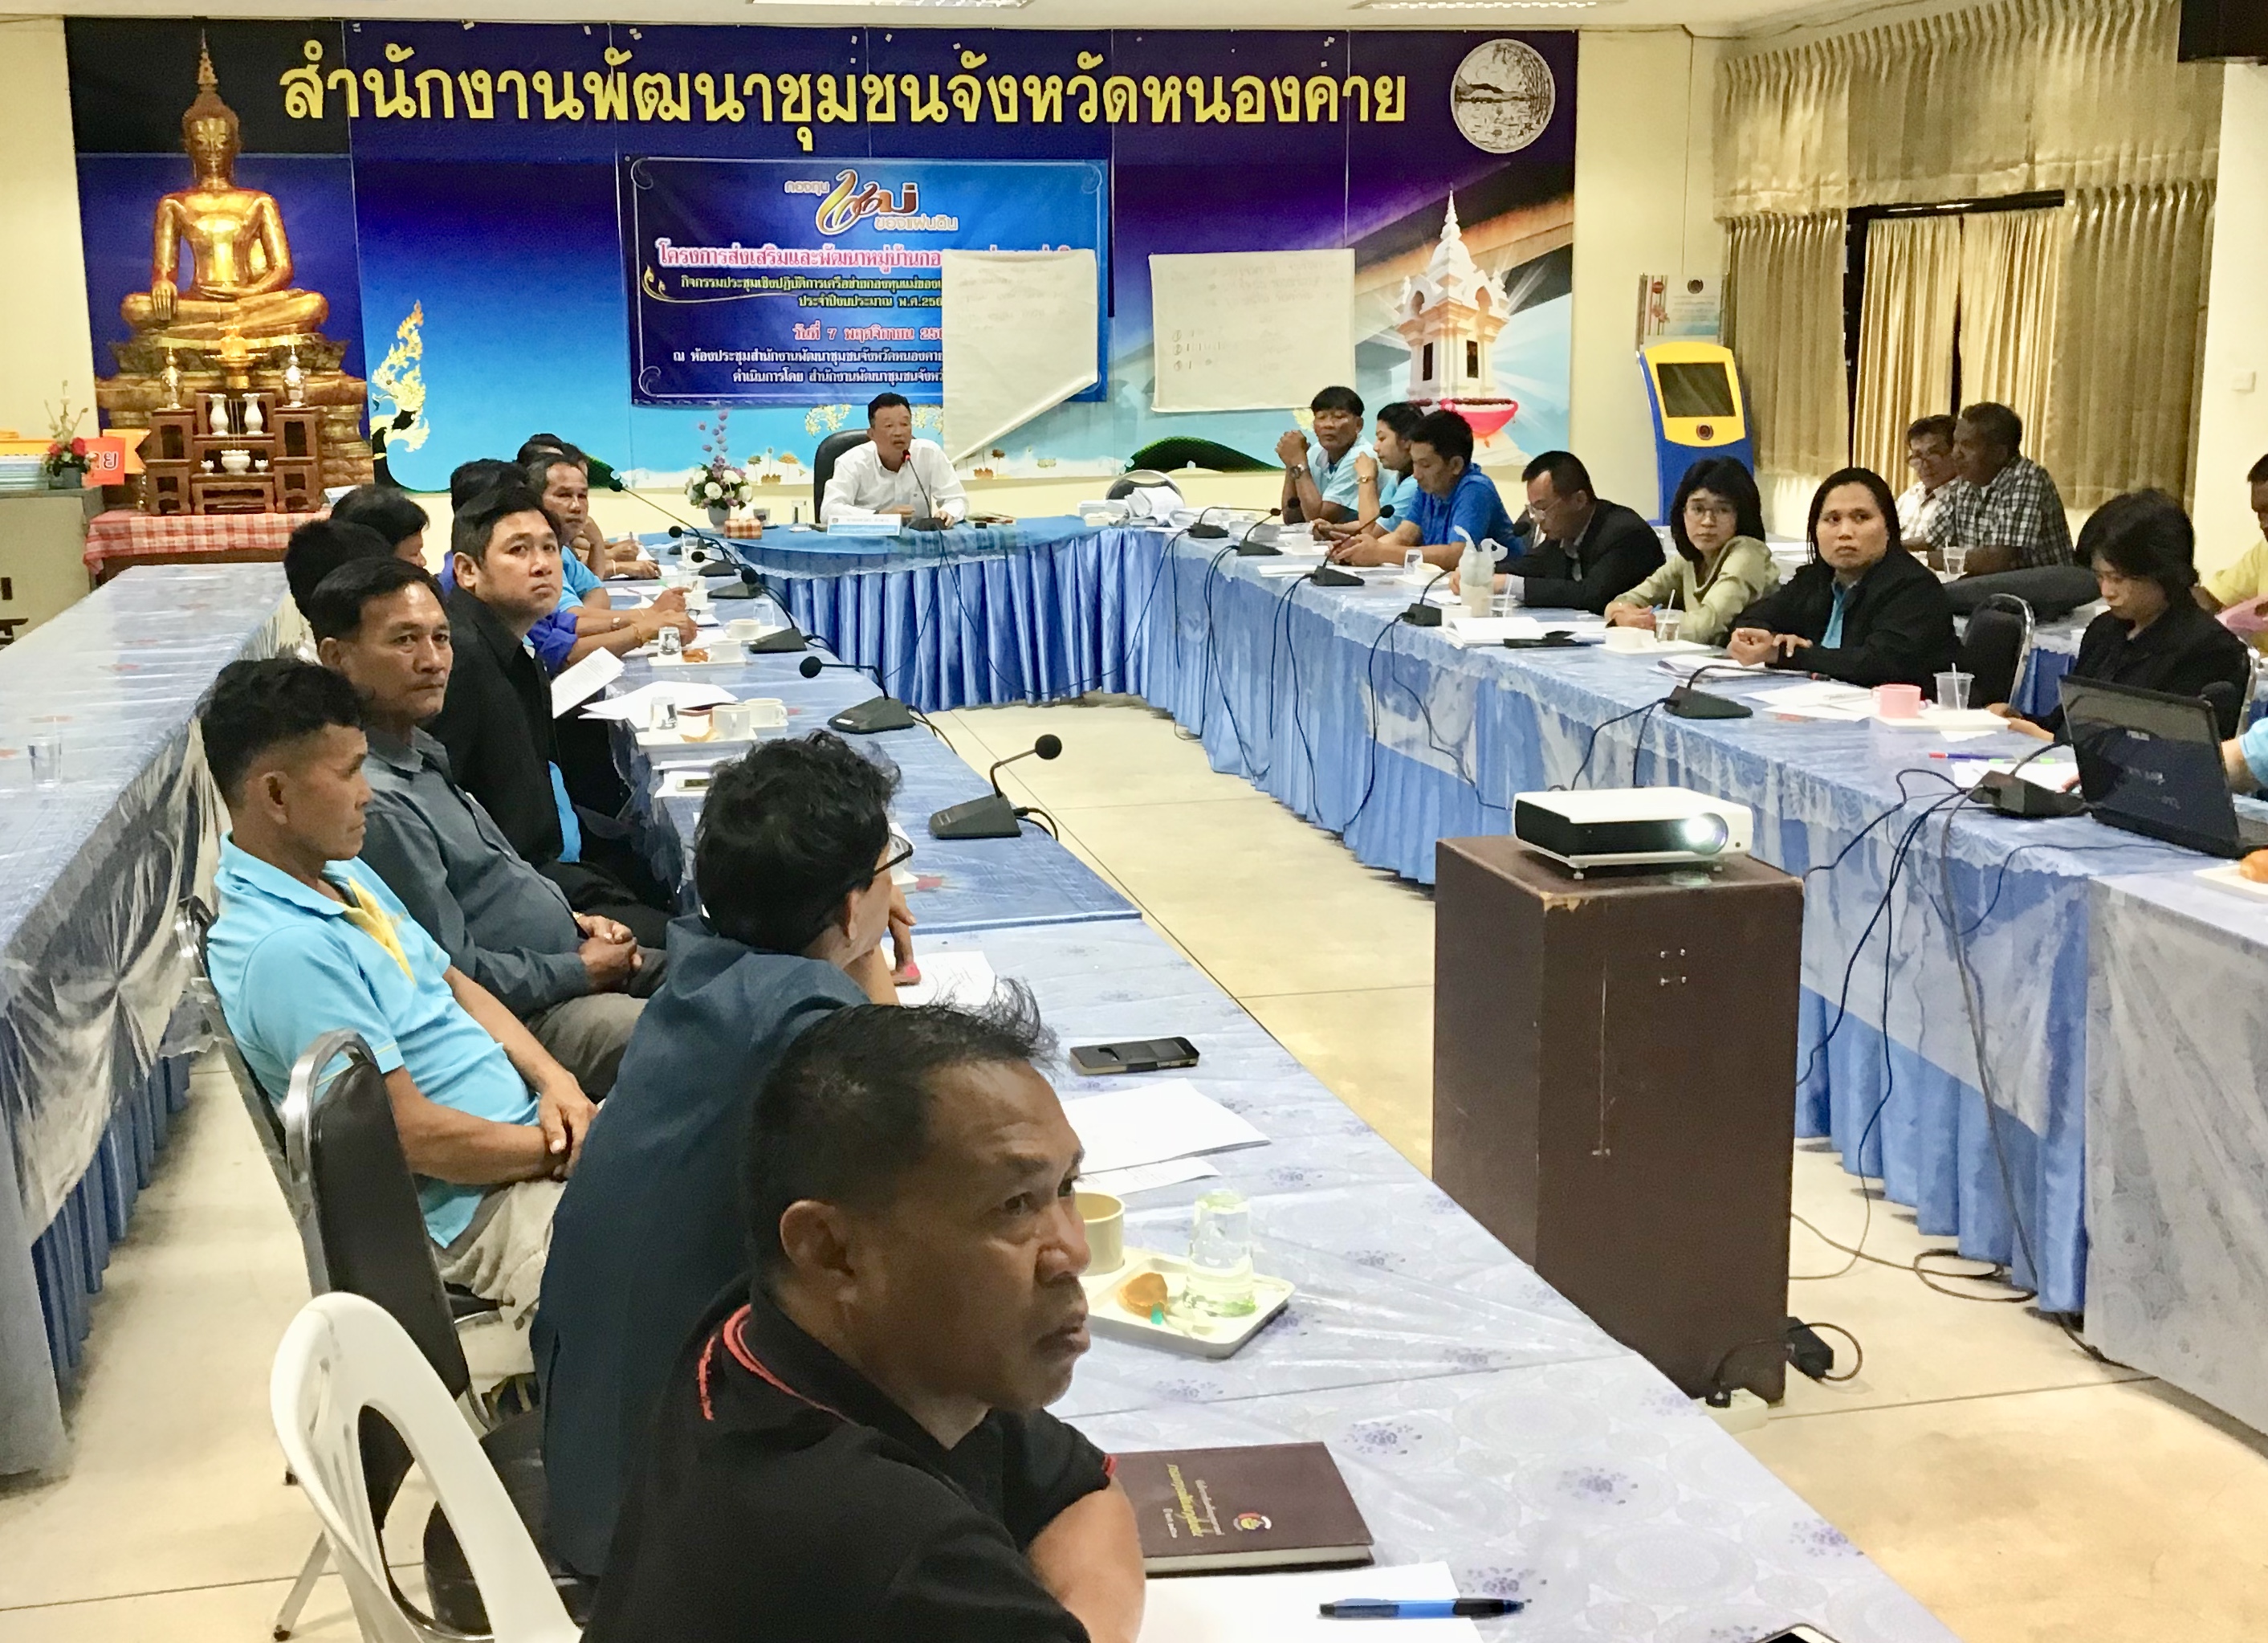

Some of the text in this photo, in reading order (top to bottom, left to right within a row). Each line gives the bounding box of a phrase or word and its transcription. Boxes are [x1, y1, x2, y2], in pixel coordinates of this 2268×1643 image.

[279, 39, 1406, 151] สำนักงานพัฒนาชุมชนจังหวัดหนองคาย
[784, 181, 830, 196] กองทุน
[656, 238, 943, 273] โครงการส่งเสริมและพัฒนาหมู่บ้านกอ
[799, 293, 893, 307] ประจำปีงบประมาณ
[792, 320, 820, 340] วันที่
[827, 328, 837, 340] 7
[844, 324, 914, 343] พฤศจิกายน
[673, 352, 685, 362] ณ
[733, 367, 943, 385] ดำเนินการโดย สำนักงานพัฒนาชุมชนจังหวั
